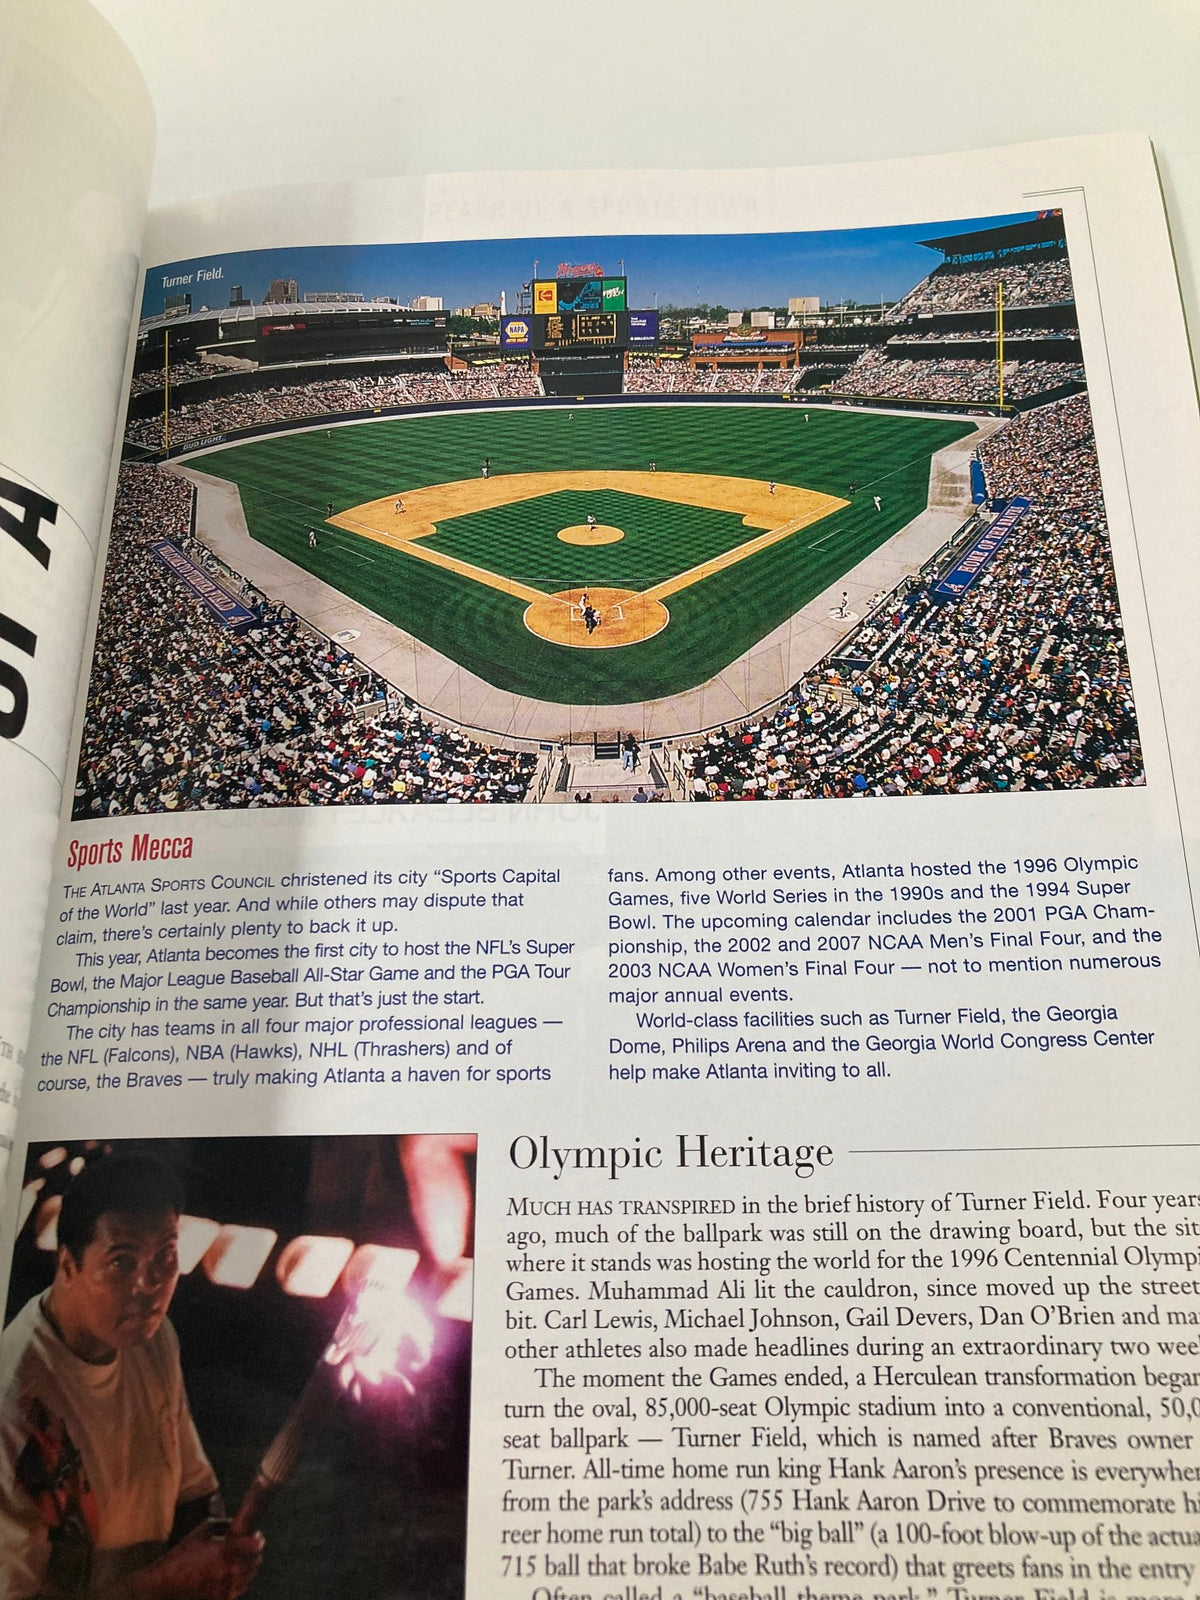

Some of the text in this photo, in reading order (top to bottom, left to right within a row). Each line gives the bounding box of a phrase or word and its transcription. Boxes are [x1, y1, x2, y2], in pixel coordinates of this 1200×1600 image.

[162, 267, 224, 288] Turner Field.
[183, 435, 223, 450] BUD LIGHT
[68, 834, 193, 872] Sports Mecca
[281, 871, 367, 887] christened
[373, 870, 392, 885] its
[398, 870, 428, 887] city
[502, 869, 560, 886] Capital
[608, 855, 1138, 885] fans. Among other events, Atlanta hosted the 1996 Olympic
[59, 907, 74, 922] of
[77, 906, 100, 920] the
[161, 900, 189, 915] last
[193, 902, 230, 917] year.
[236, 897, 270, 912] And
[276, 896, 318, 911] while
[324, 895, 376, 909] others
[382, 896, 418, 911] may
[424, 893, 486, 910] dispute
[491, 892, 524, 907] that
[609, 938, 687, 957] pionship,
[694, 938, 722, 953] the
[728, 937, 771, 952] 2002
[778, 936, 811, 952] and
[818, 936, 860, 951] 2007
[869, 934, 924, 950] NCAA
[990, 931, 1033, 947] Final
[1040, 931, 1085, 947] Four,
[1092, 928, 1126, 944] and
[1132, 927, 1162, 943] the
[48, 997, 151, 1018] Championship
[155, 997, 168, 1011] in
[174, 996, 198, 1011] the
[203, 998, 247, 1010] same
[252, 996, 289, 1012] year.
[295, 992, 324, 1007] But
[376, 990, 407, 1009] just
[412, 990, 438, 1005] the
[443, 990, 484, 1005] start.
[41, 1039, 513, 1067] the NFL (Falcons), NBA (Hawks), NHL (Thrashers) and of
[610, 1030, 1155, 1057] Dome, Philips Arena and the Georgia World Congress Center
[610, 1061, 890, 1084] help make Atlanta inviting to all.
[510, 1135, 834, 1180] Olympic Heritage
[742, 1196, 761, 1214] in
[767, 1194, 799, 1214] the
[804, 1194, 852, 1213] brief
[856, 1194, 925, 1218] history
[931, 1192, 952, 1212] of
[955, 1192, 1027, 1211] Turner
[1032, 1189, 1090, 1210] Field.
[1096, 1190, 1147, 1208] Four
[506, 1275, 1200, 1302] Games. Muhammad Ali lit the cauldron, since moved up the street
[534, 1368, 575, 1388] The
[582, 1372, 665, 1387] moment
[671, 1366, 702, 1387] the
[709, 1367, 777, 1387] Games
[784, 1365, 848, 1390] ended,
[856, 1372, 867, 1386] a
[872, 1364, 978, 1386] Herculean
[984, 1364, 1137, 1386] transformation
[502, 1555, 536, 1577] 715
[545, 1553, 579, 1577] ball
[588, 1553, 627, 1577] that
[633, 1552, 690, 1576] broke
[698, 1552, 747, 1576] Babe
[824, 1553, 898, 1581] record)
[905, 1553, 946, 1577] that
[953, 1561, 1015, 1585] greets
[1022, 1554, 1063, 1578] fans
[1070, 1556, 1091, 1579] in
[1098, 1555, 1131, 1579] the
[1139, 1563, 1194, 1586] entry
